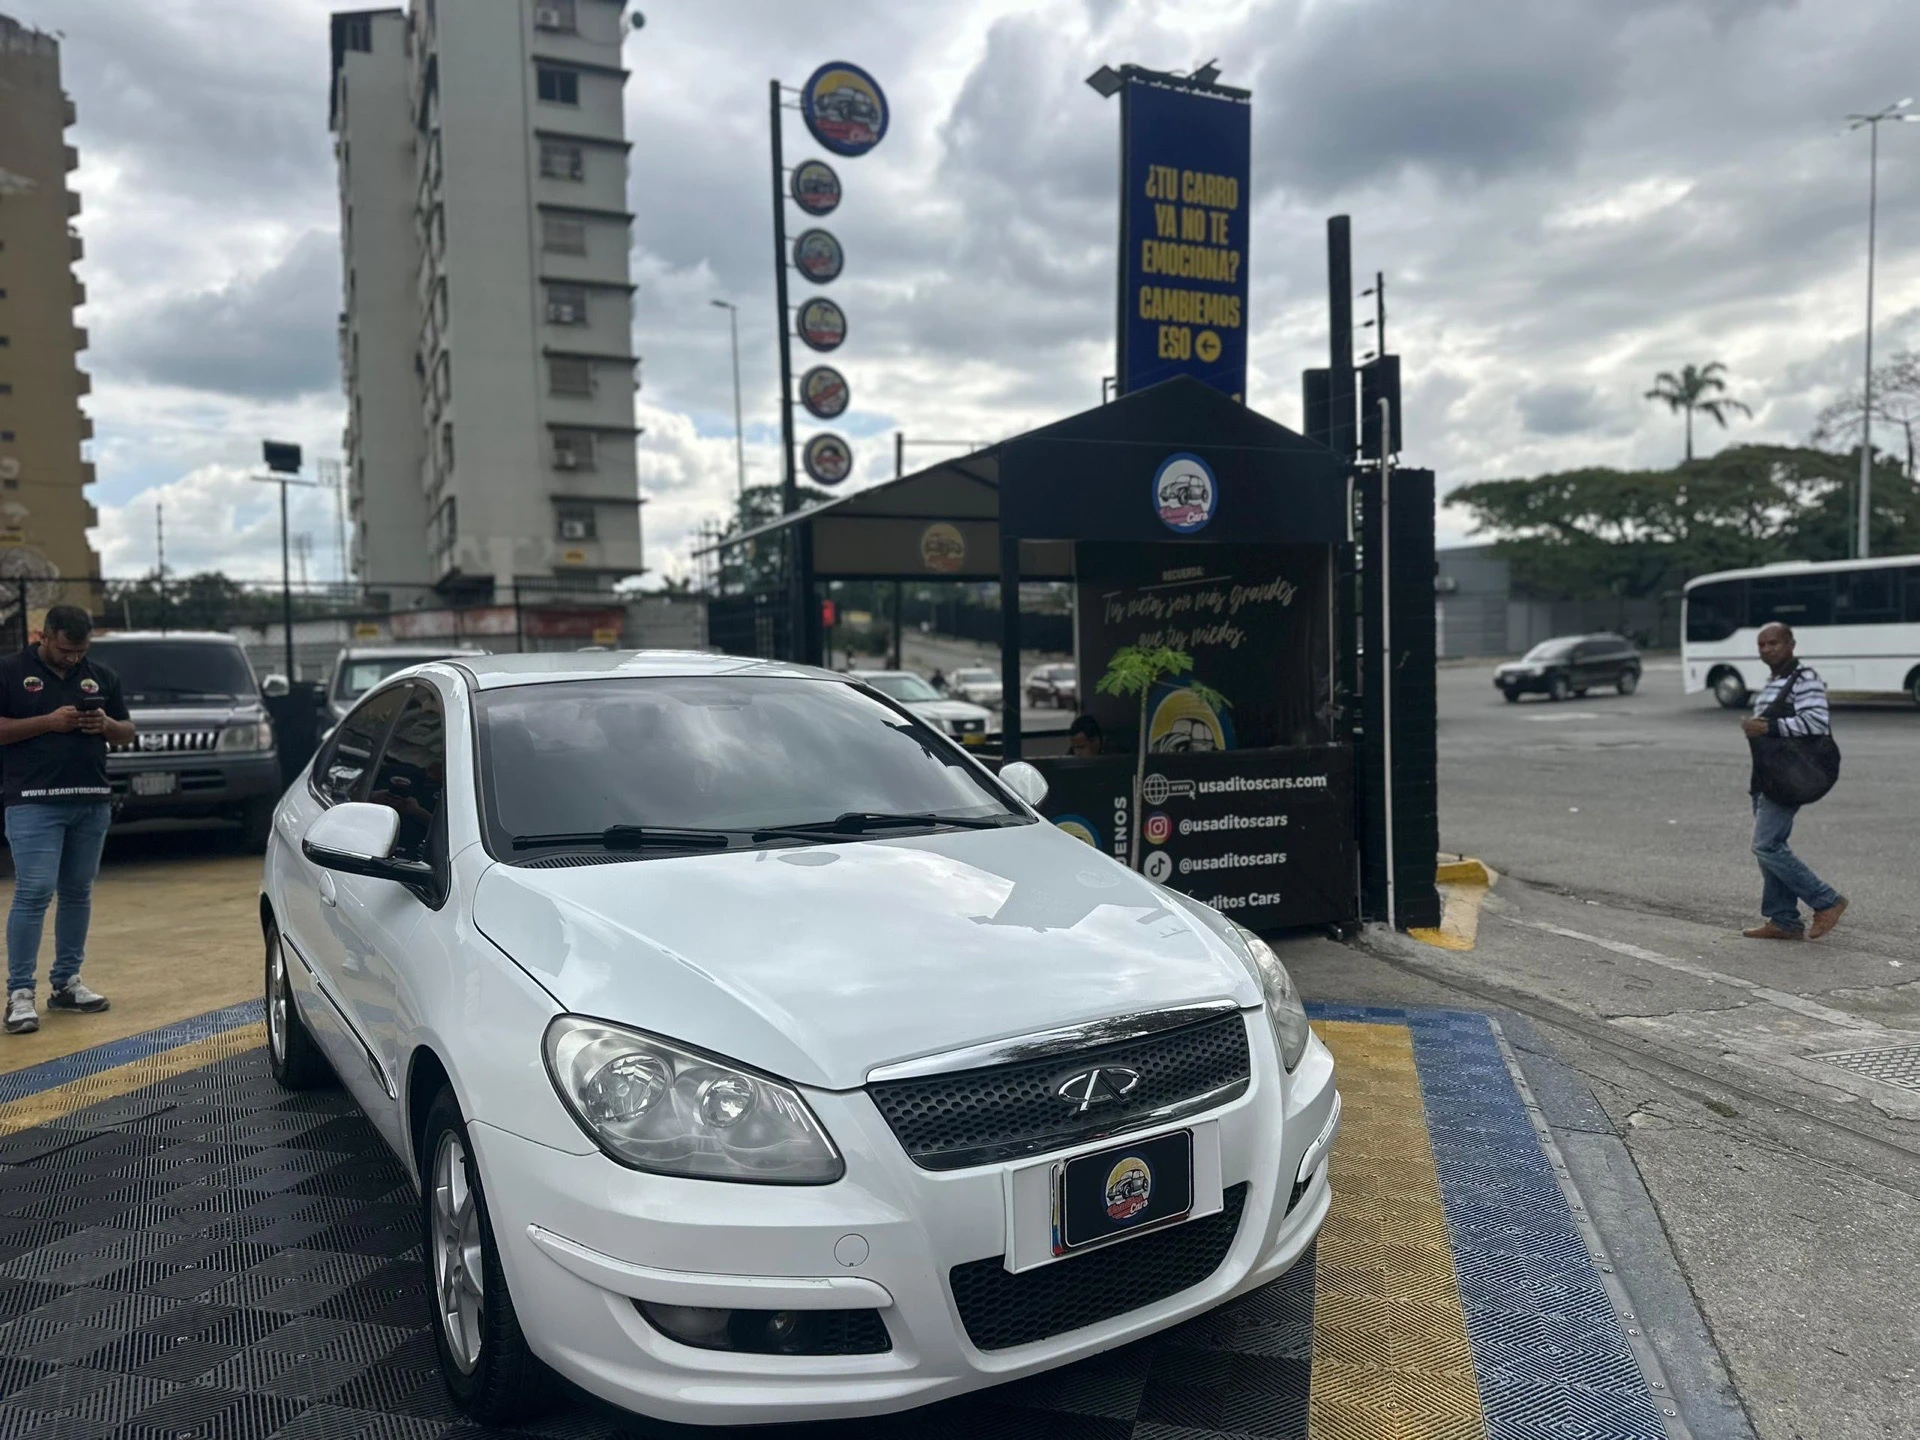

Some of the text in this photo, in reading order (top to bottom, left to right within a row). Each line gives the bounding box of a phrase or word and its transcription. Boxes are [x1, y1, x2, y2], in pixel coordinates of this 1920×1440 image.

[1146, 165, 1238, 210] ¿TU CARRO
[1156, 204, 1229, 244] YA NO TE
[1142, 240, 1240, 282] EMOCIONA?
[1140, 286, 1240, 328] CAMBIEMOS
[1159, 325, 1191, 360] ESO
[1127, 593, 1163, 619] metas
[1165, 595, 1192, 618] son
[1198, 774, 1328, 794] usaditoscars.com
[1179, 814, 1288, 835] @usaditoscars
[1179, 851, 1287, 874] @usaditoscars
[1248, 891, 1281, 907] Cars
[1130, 1199, 1149, 1213] Cars
